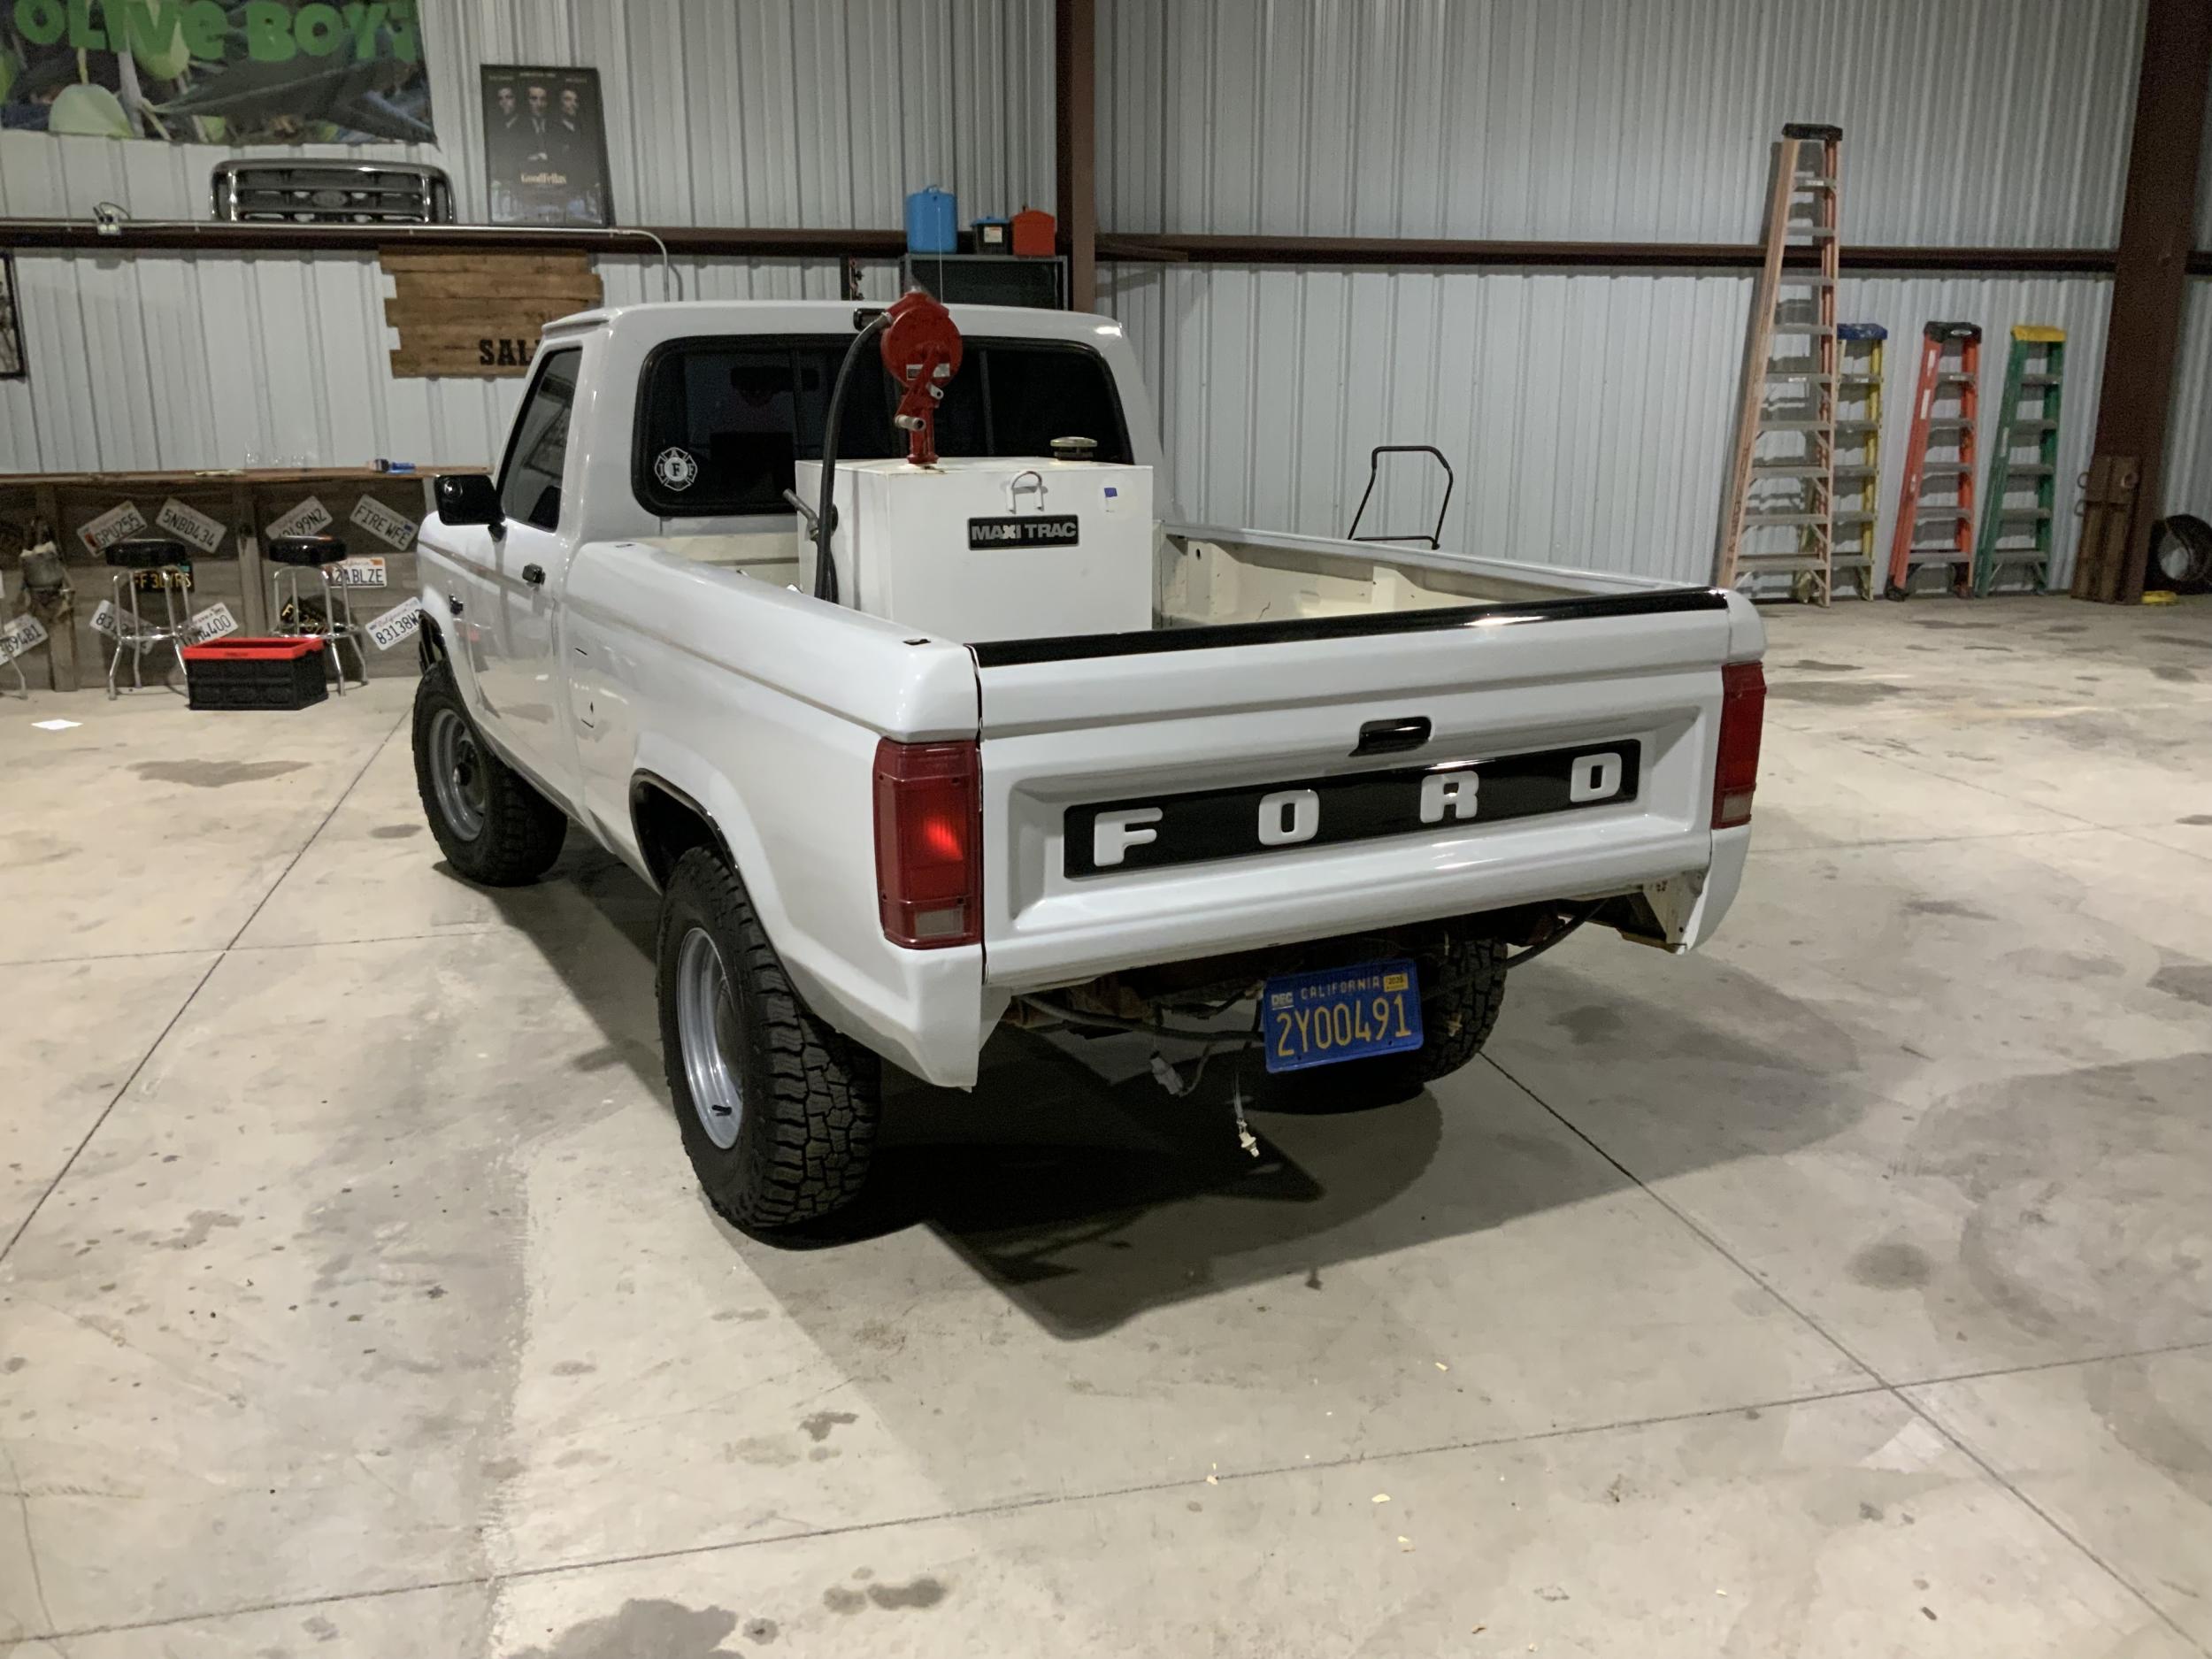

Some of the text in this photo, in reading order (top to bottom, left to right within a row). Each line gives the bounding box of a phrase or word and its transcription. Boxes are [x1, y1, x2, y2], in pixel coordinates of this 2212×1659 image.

[355, 504, 388, 532] FIRE
[972, 522, 1077, 541] MAXI TRAC
[1093, 752, 1623, 867] FORD
[1300, 975, 1380, 1001] CALIFORNIA
[1276, 993, 1411, 1057] 2Y00491
